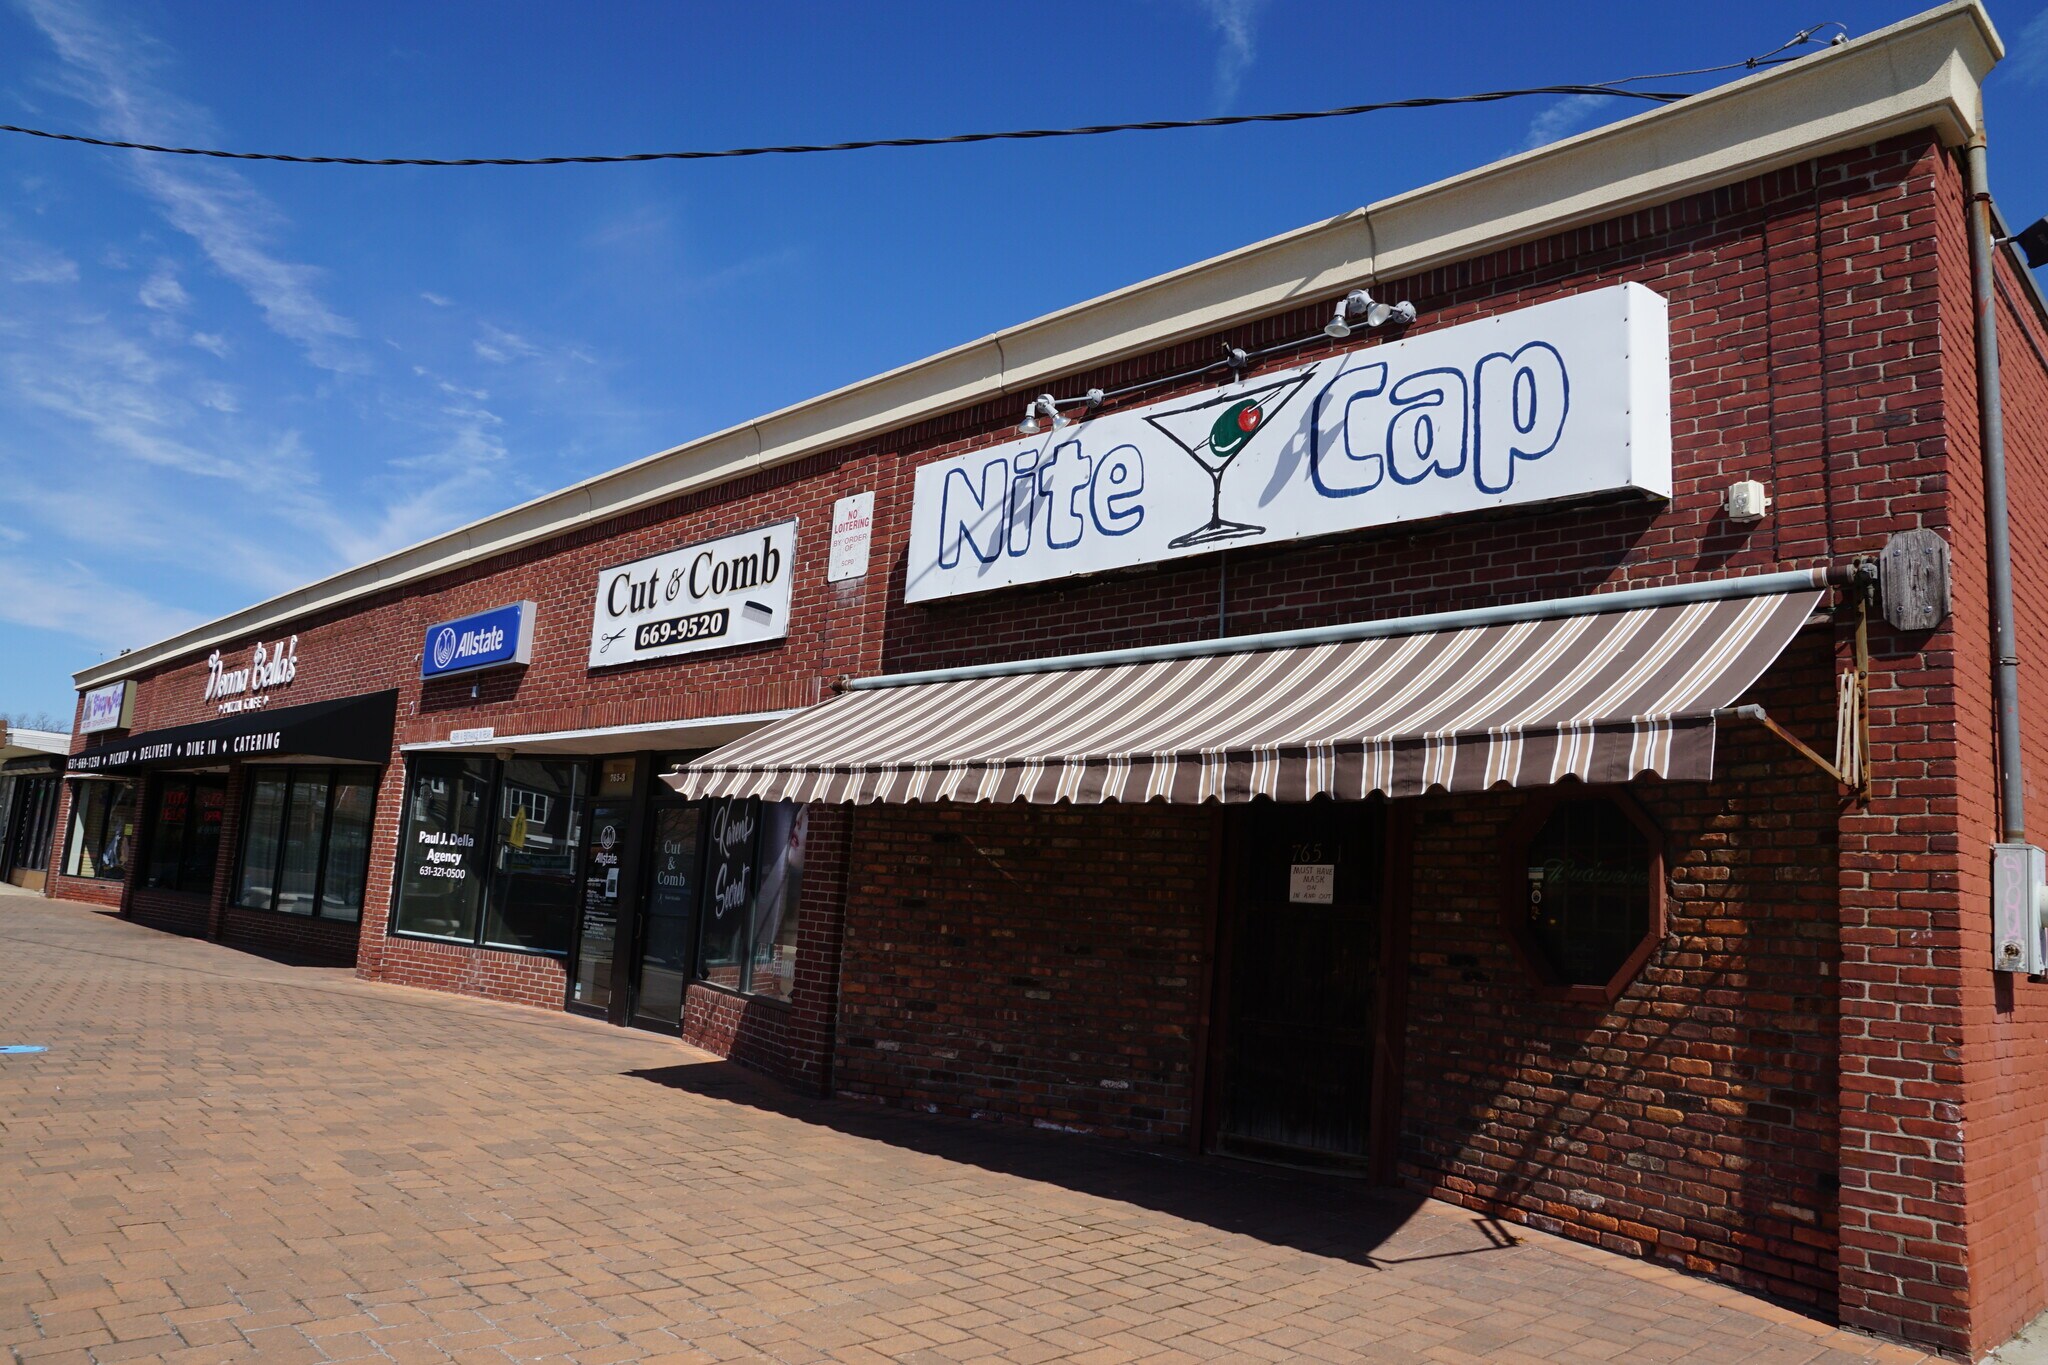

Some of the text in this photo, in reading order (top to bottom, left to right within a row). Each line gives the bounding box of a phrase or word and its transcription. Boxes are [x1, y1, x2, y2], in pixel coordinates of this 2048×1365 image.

[938, 339, 1571, 570] Nite Cap
[848, 509, 858, 520] NO
[834, 517, 870, 534] LOITERING
[833, 533, 868, 547] BY ORDER
[844, 543, 854, 552] OF
[607, 535, 781, 618] Cut & Comb
[639, 611, 723, 647] 669-9520
[455, 625, 504, 659] Allstate
[204, 634, 298, 701] Nonna Bella's
[108, 750, 130, 766] PICKUP
[139, 742, 173, 761] DELIVERY
[185, 740, 205, 757] DINE
[207, 739, 217, 755] IN
[233, 731, 281, 753] CATERING
[713, 797, 754, 858] Karen's
[418, 830, 475, 847] Paul J. Della
[664, 839, 681, 855] Cut
[426, 848, 462, 866] Agency
[594, 851, 618, 867] Allstate
[667, 856, 677, 870] &
[419, 865, 466, 879] 631-321-0500
[657, 871, 686, 887] Comb
[1292, 866, 1333, 876] MUST HAVE
[1302, 875, 1326, 884] MASK
[1543, 858, 1649, 884] Budweise
[715, 862, 751, 920] Secret
